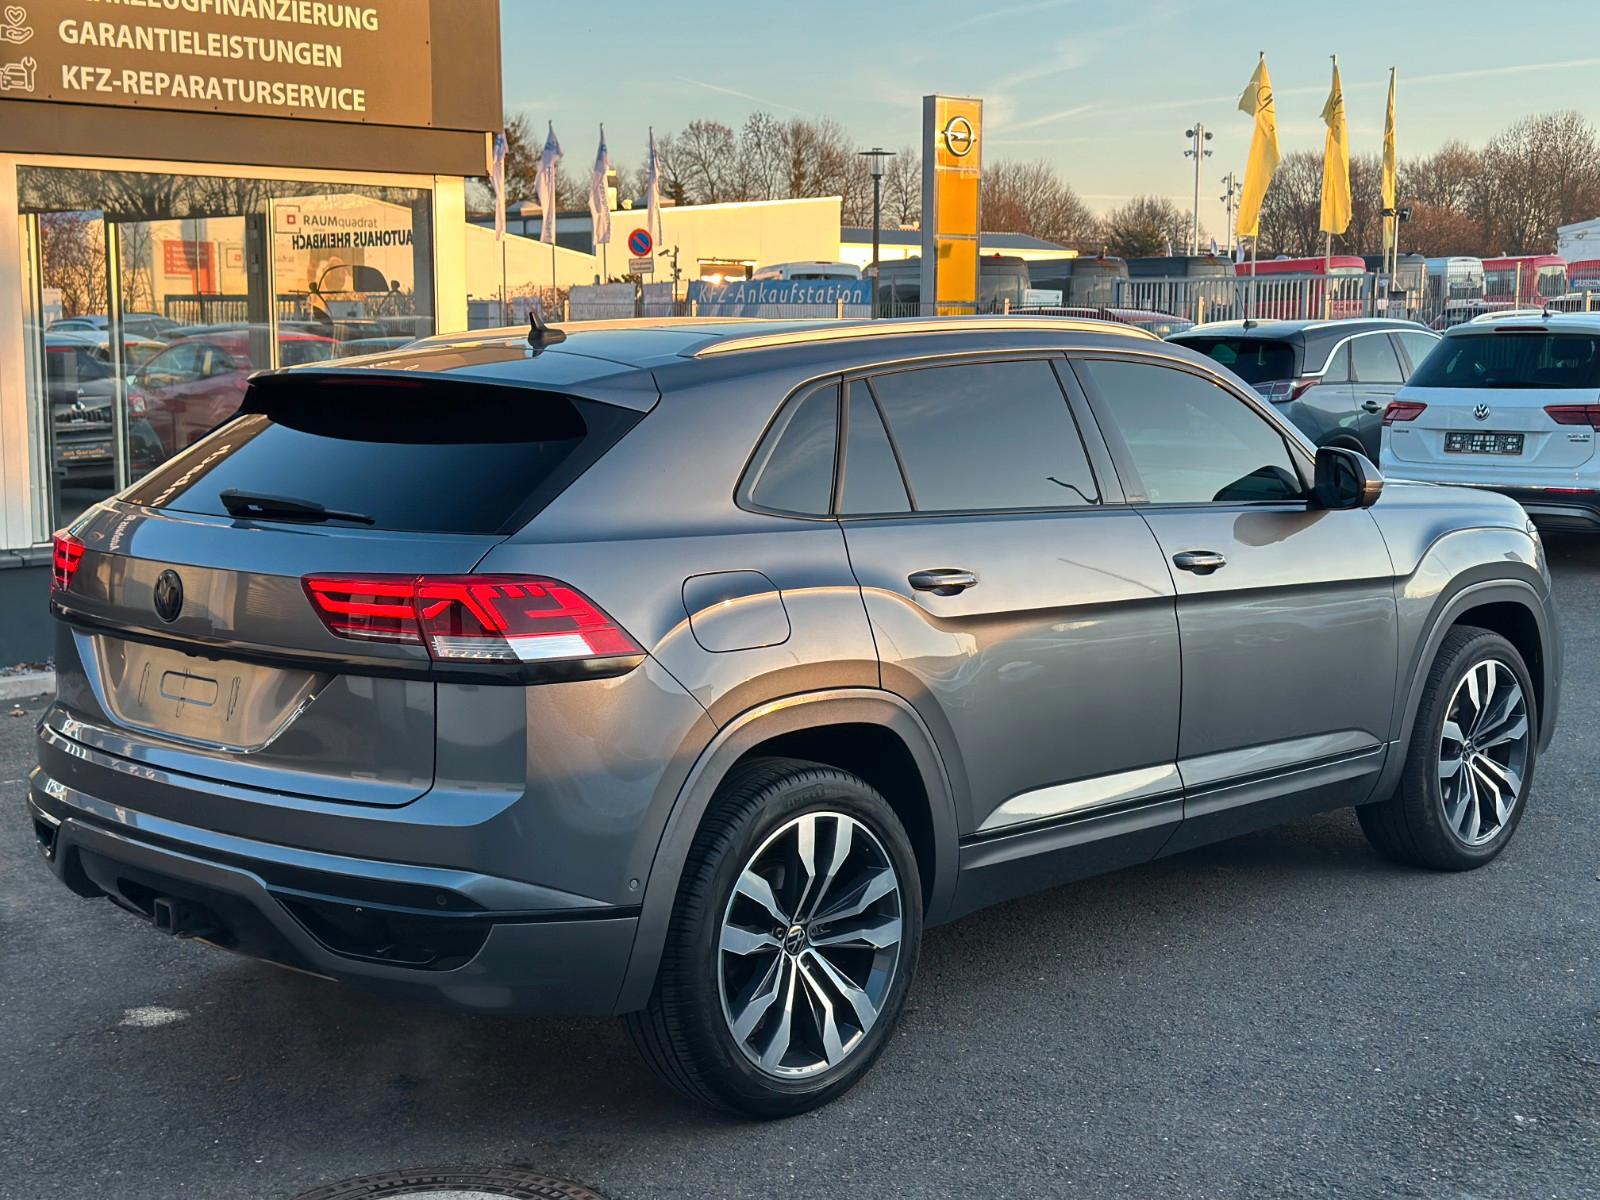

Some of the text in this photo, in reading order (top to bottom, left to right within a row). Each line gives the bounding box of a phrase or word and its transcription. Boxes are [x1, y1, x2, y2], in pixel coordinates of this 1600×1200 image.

[59, 19, 342, 68] GARANTIELEISTUNGEN
[62, 65, 366, 111] KFZ-REPARATURSERVICE
[303, 215, 377, 229] RAUMquadrat
[699, 283, 862, 303] KFZ-Ankaufstation
